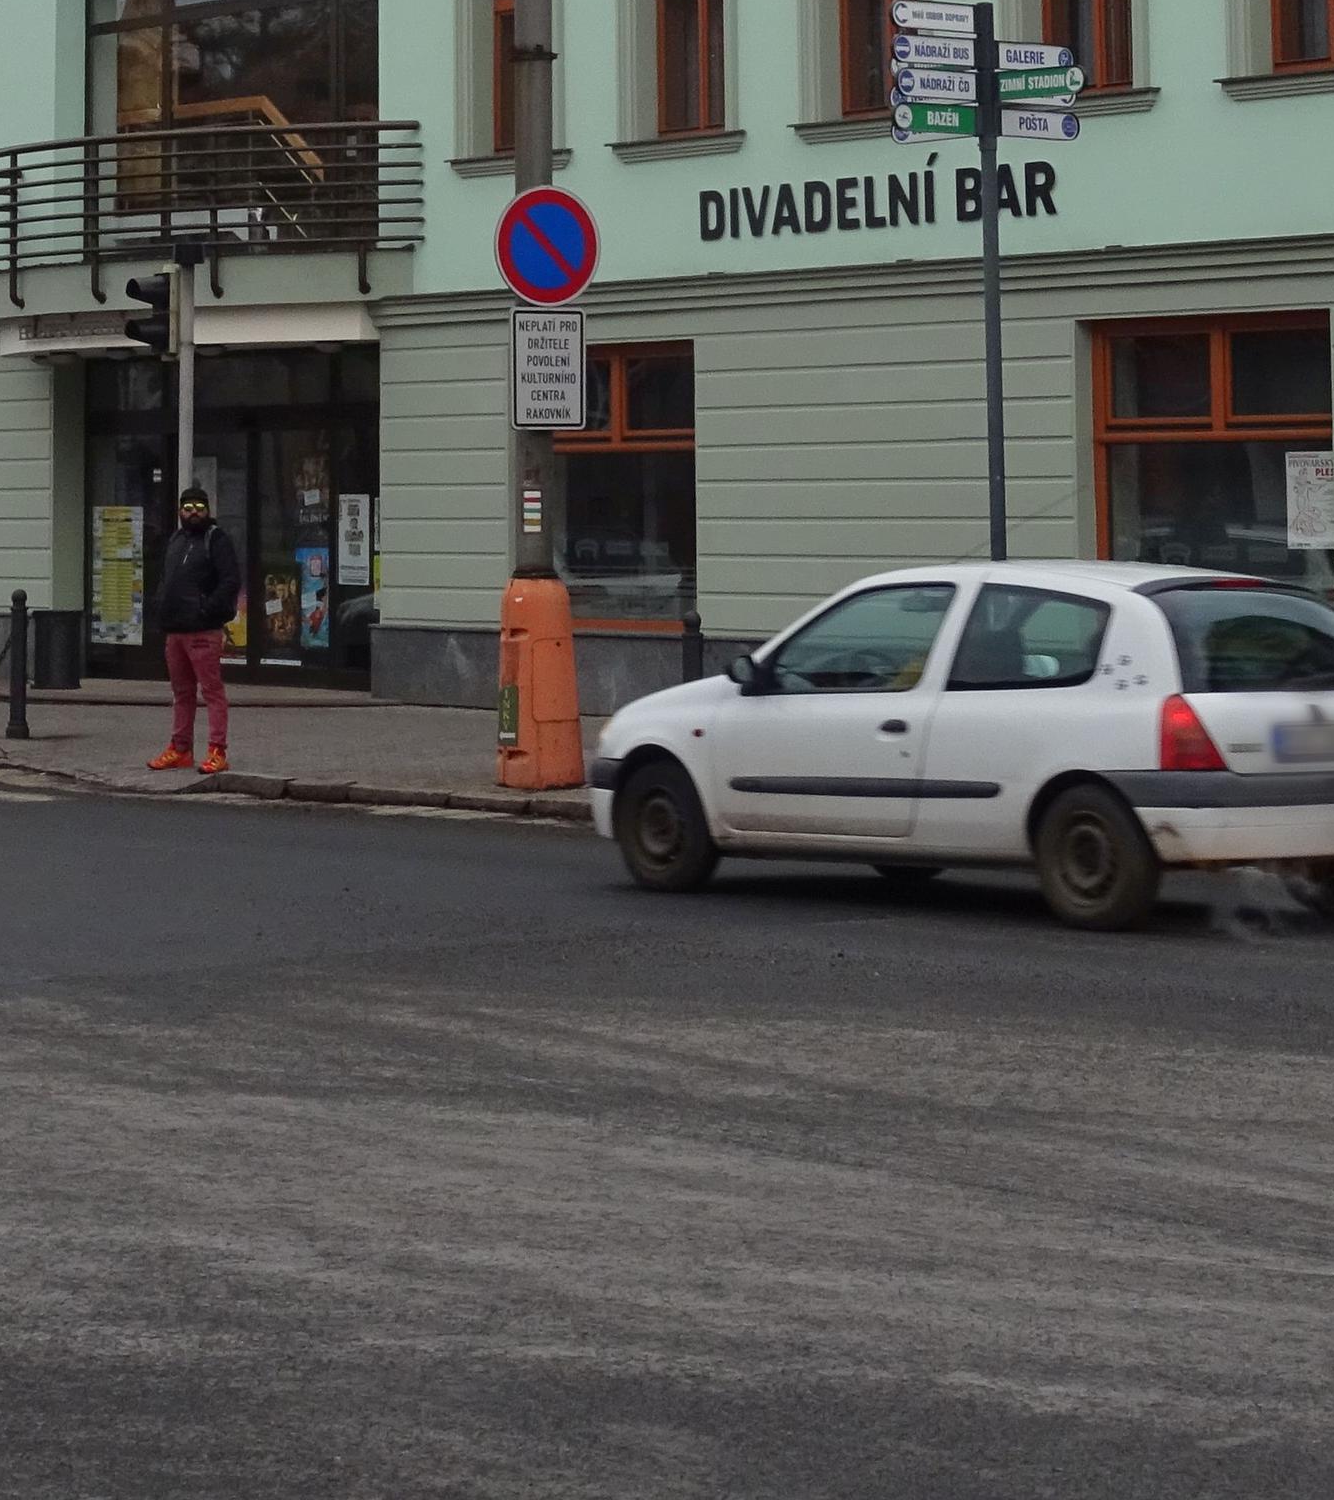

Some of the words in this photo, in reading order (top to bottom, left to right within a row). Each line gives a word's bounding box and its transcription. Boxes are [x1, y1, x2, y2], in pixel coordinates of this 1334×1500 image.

[914, 41, 951, 59] NÁDRAŽÍ
[952, 47, 970, 60] BUS
[1005, 49, 1045, 65] GALERIE
[919, 74, 956, 92] NÁDRAŽÍ
[958, 76, 970, 92] ČD
[1000, 74, 1026, 92] ZIMNÍ
[1027, 74, 1065, 90] STADION
[926, 108, 959, 127] BAZÉN
[1018, 114, 1049, 132] POŠTA
[699, 152, 939, 242] DIVADELNÍ
[955, 160, 1058, 223] BAR
[518, 318, 556, 332] NEPLATÍ
[559, 321, 578, 332] PRO
[527, 335, 570, 350] DRŽITELE
[526, 353, 571, 367] POVOLENÍ
[520, 370, 577, 385] KULTURNÍHO
[530, 390, 566, 402] CENTRA
[525, 405, 571, 419] RAKOVNÍK
